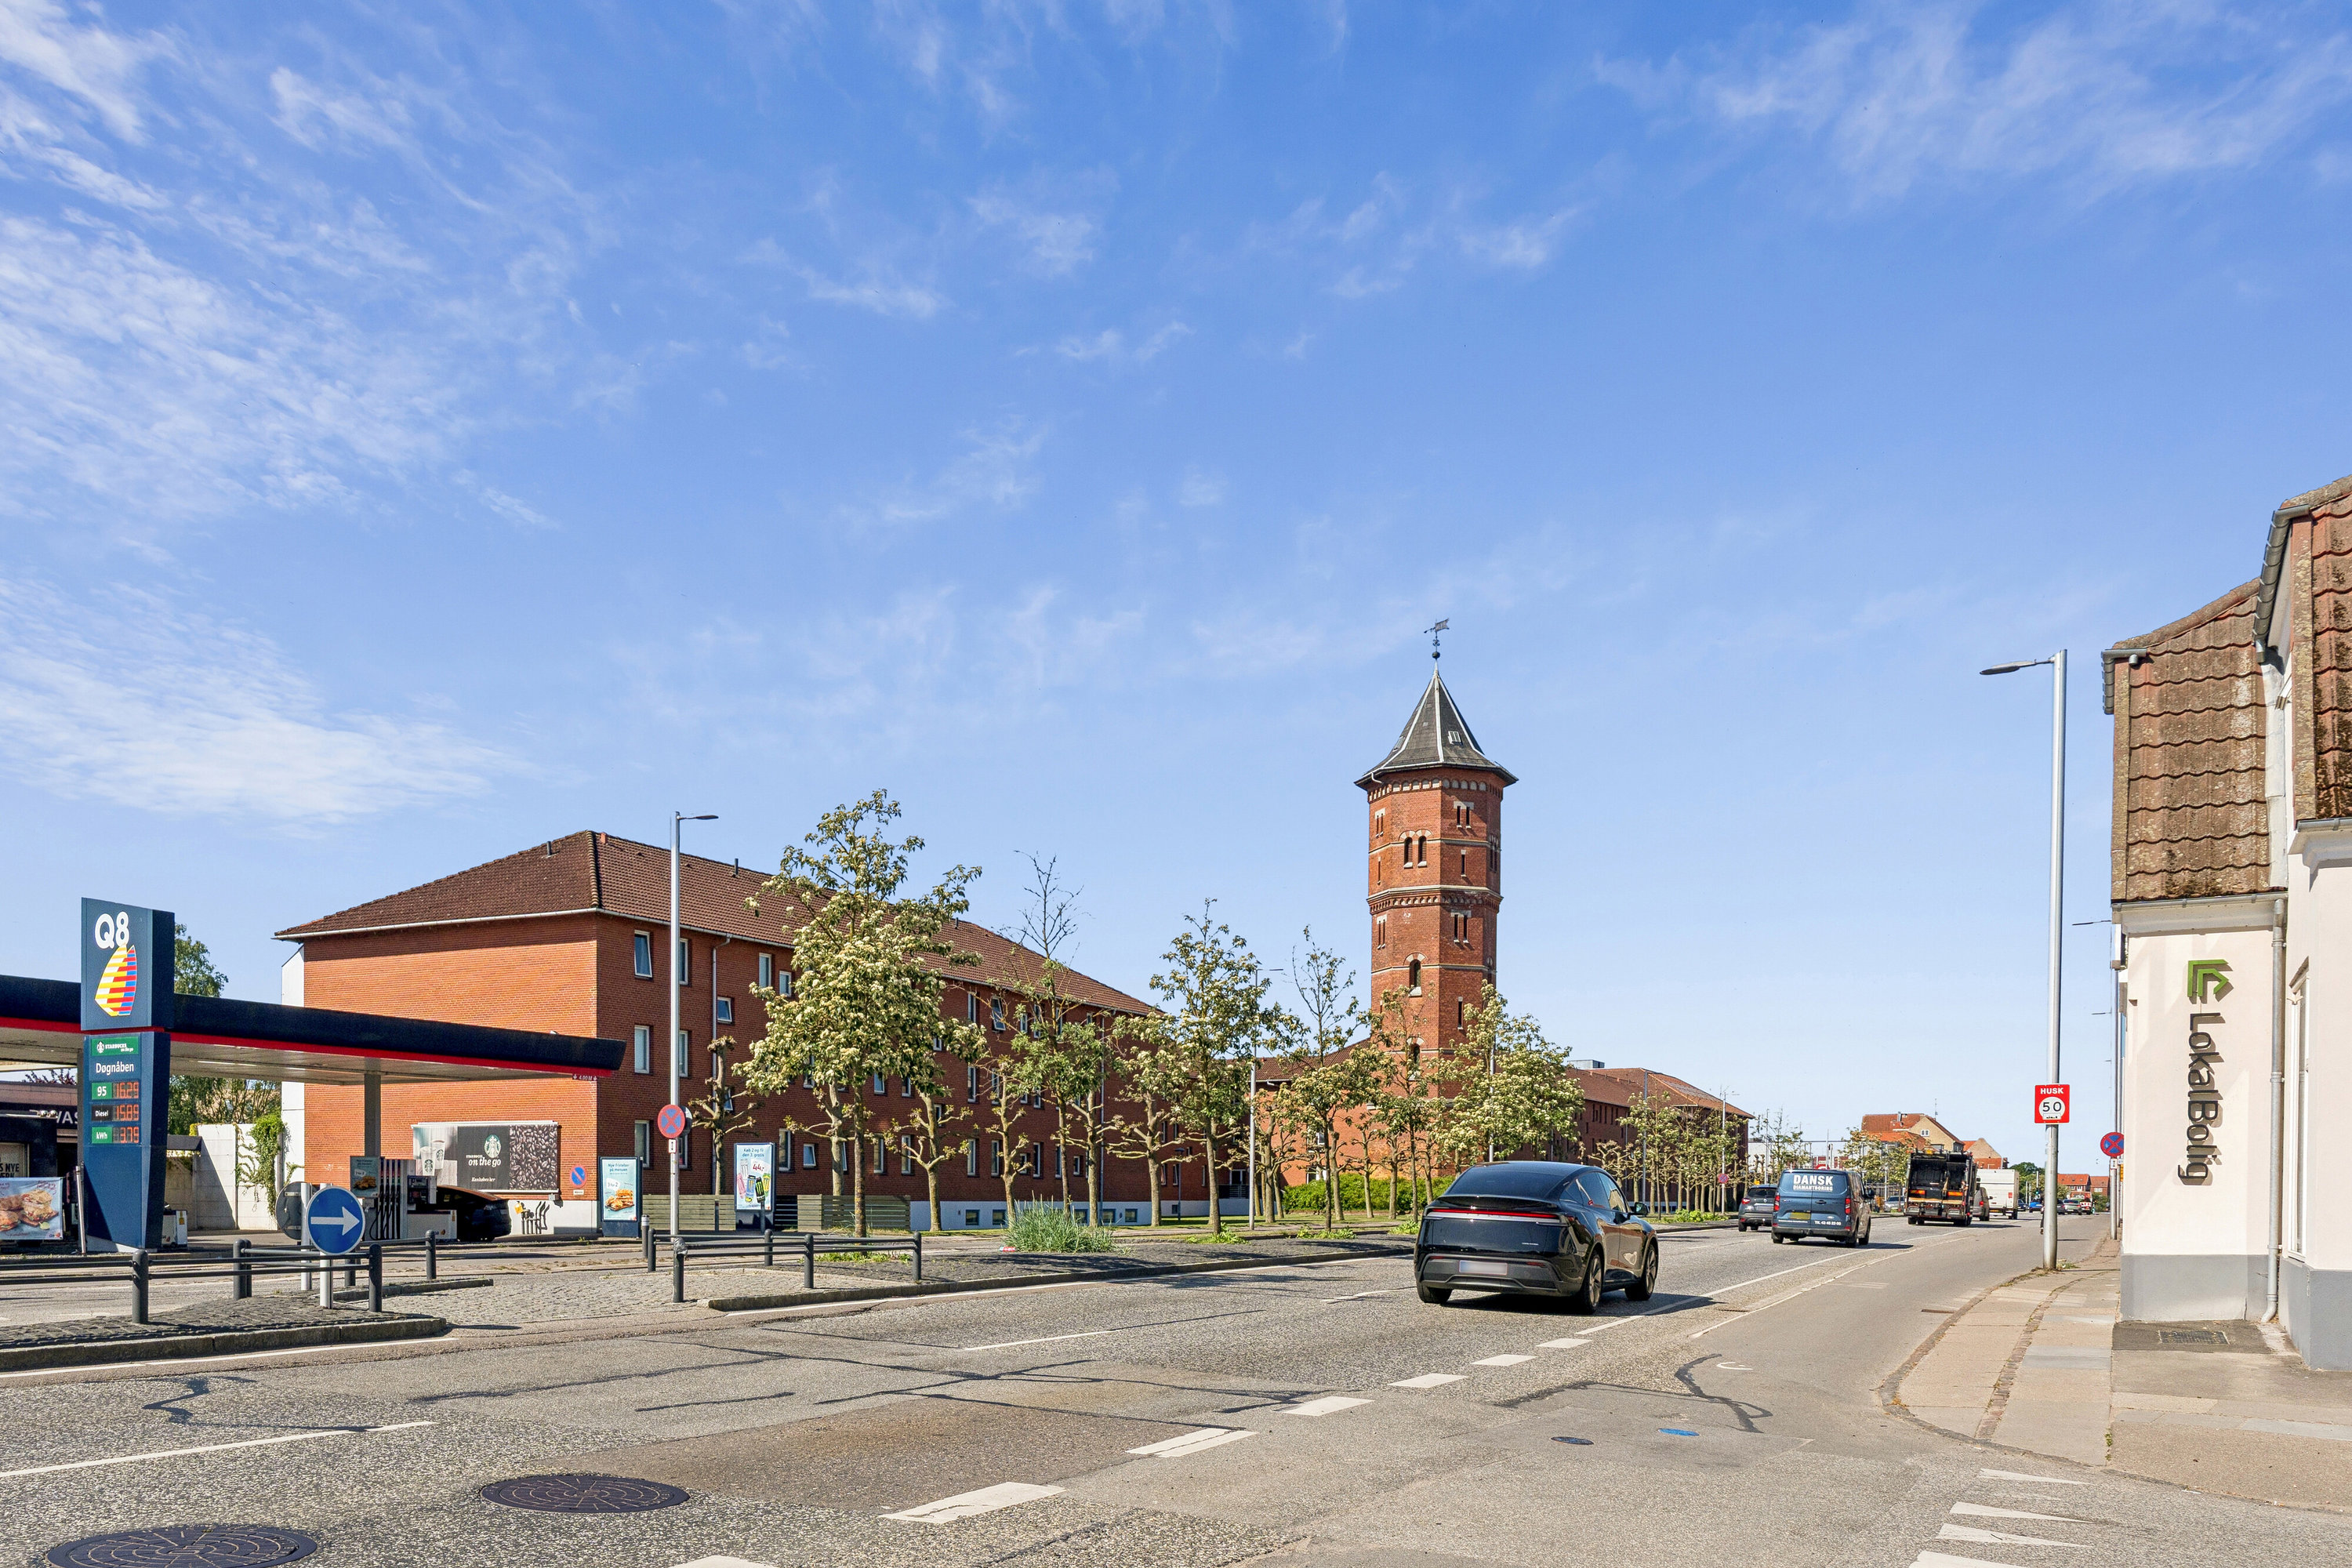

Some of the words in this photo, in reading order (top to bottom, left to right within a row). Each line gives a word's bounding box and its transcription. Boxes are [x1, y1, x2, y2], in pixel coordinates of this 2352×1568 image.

[95, 911, 129, 949] Q8
[96, 1061, 134, 1076] Døgnåben
[97, 1086, 107, 1096] 95
[2177, 1012, 2221, 1179] LokalBolig
[2042, 1102, 2062, 1112] 50
[96, 1131, 107, 1140] kWh
[5, 1163, 20, 1172] NYE
[479, 1156, 492, 1167] the
[492, 1159, 502, 1168] go
[1793, 1174, 1834, 1185] DANSK
